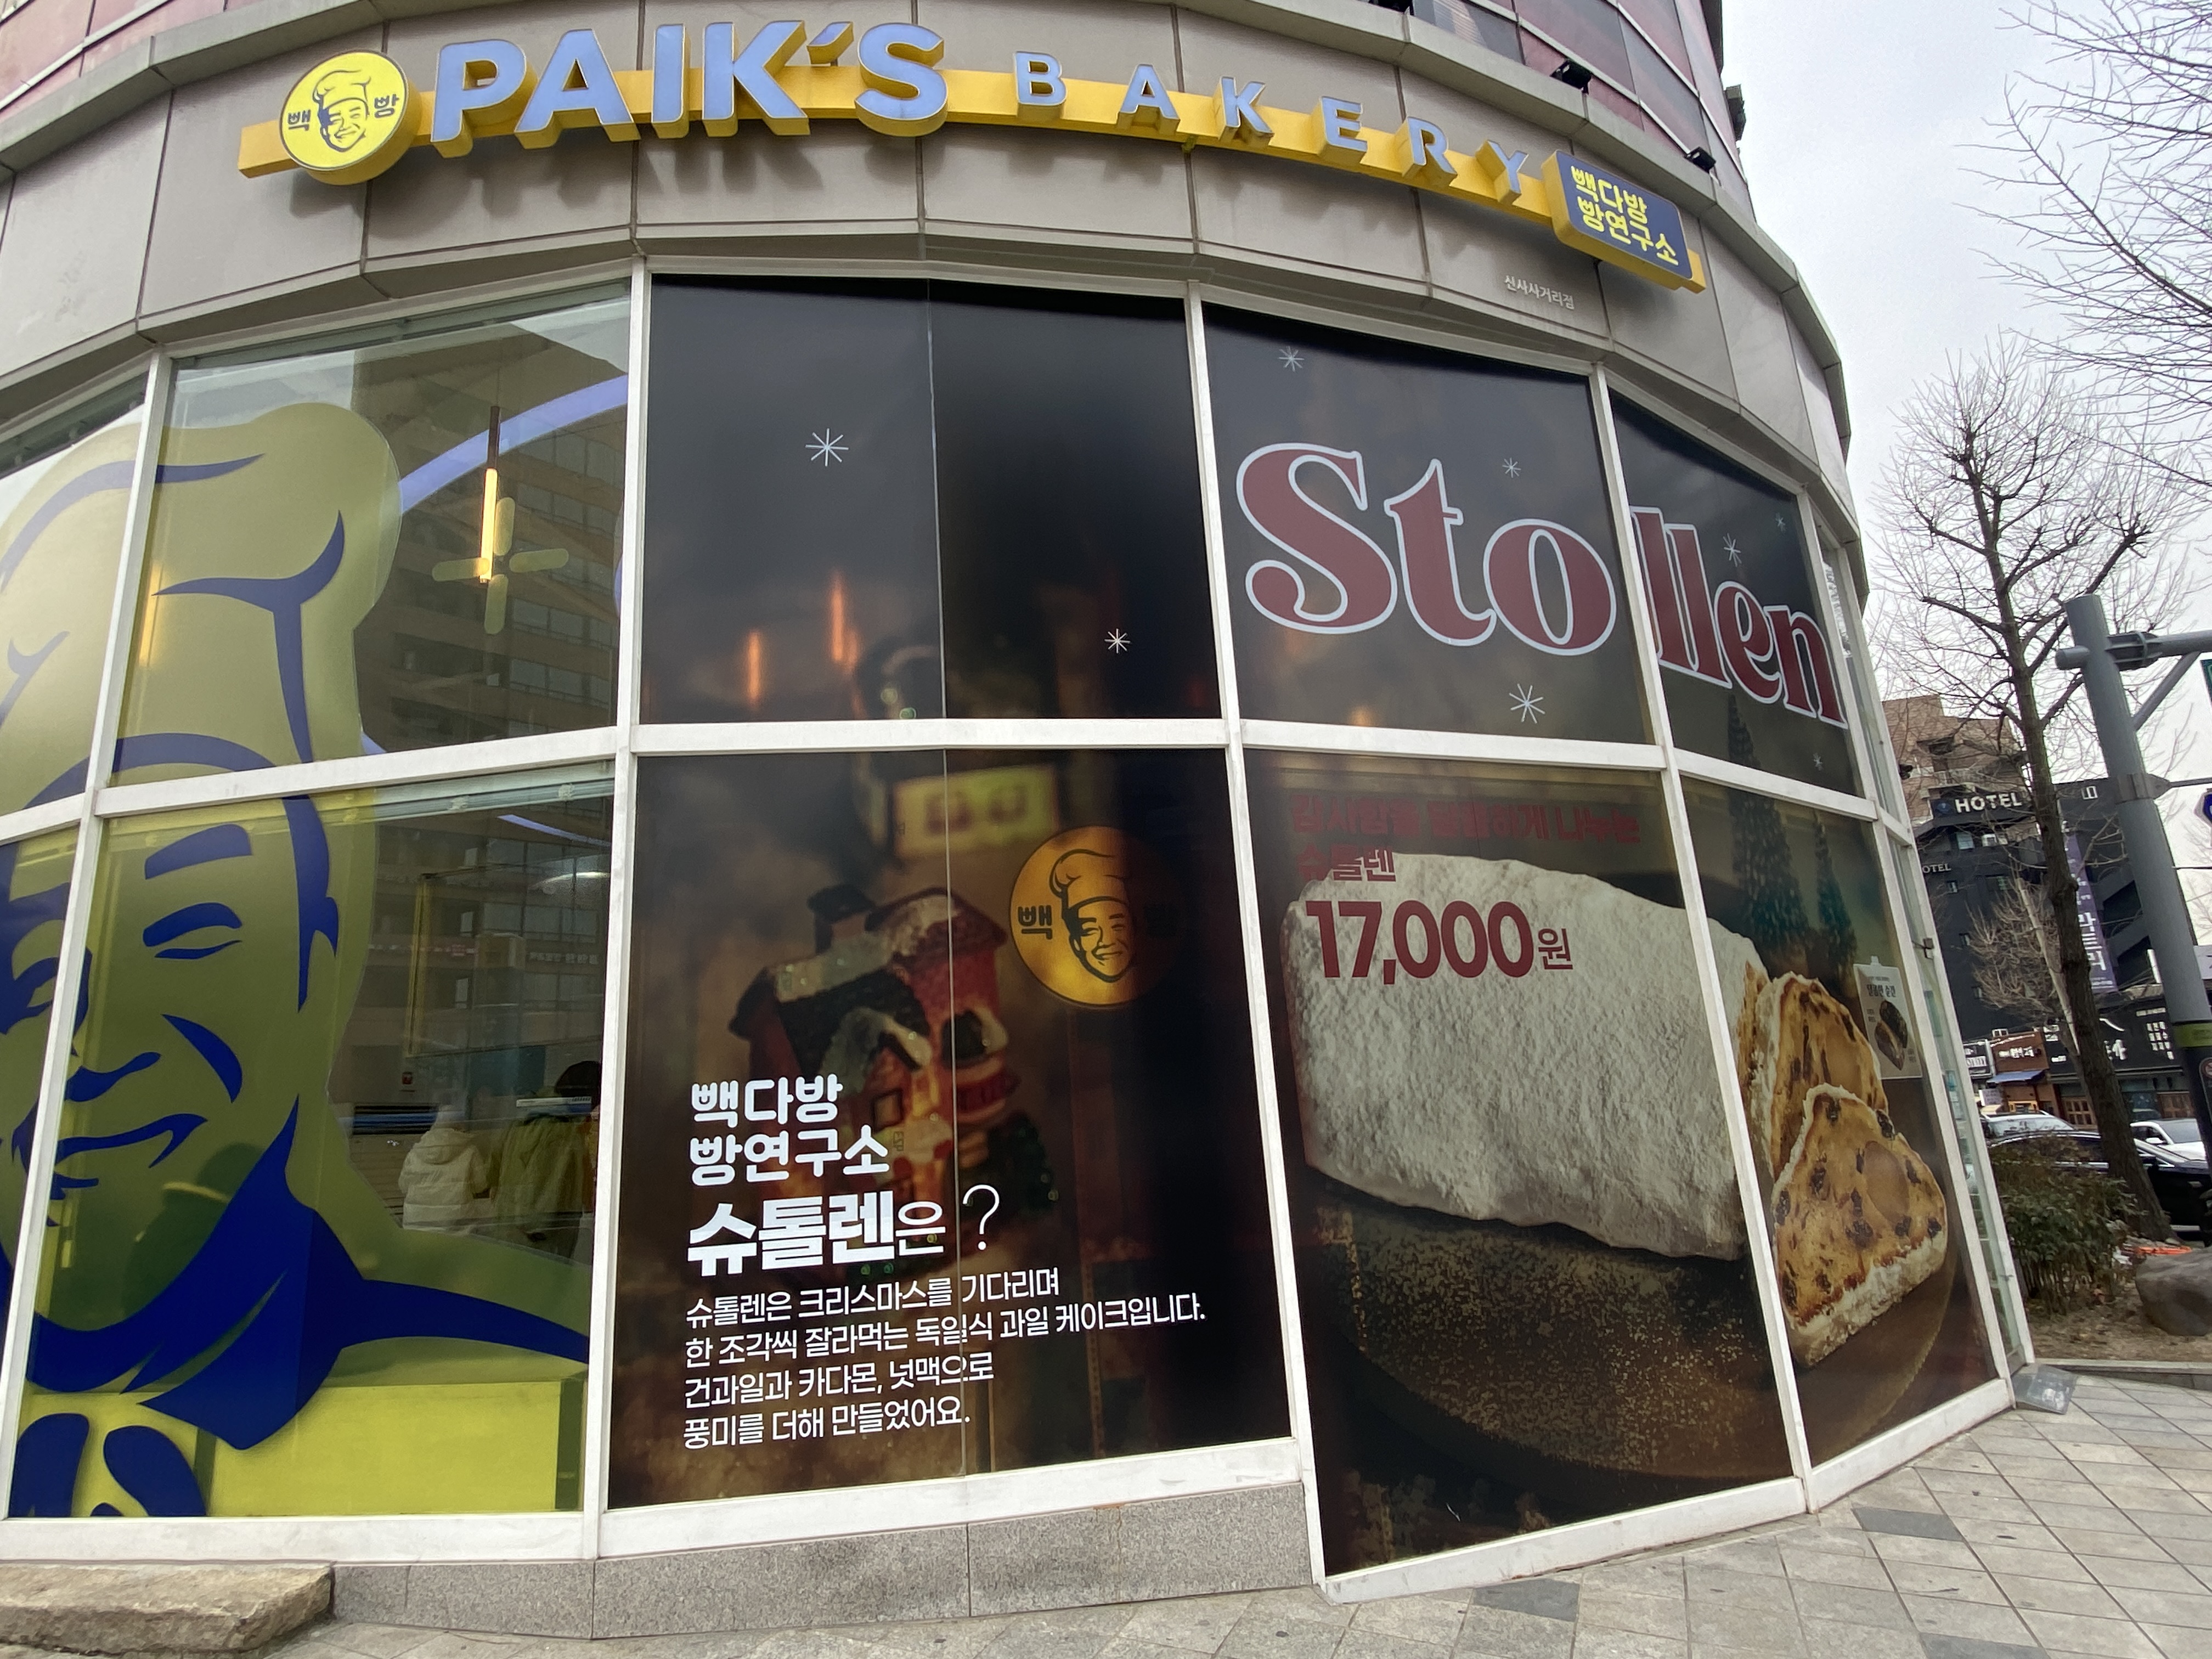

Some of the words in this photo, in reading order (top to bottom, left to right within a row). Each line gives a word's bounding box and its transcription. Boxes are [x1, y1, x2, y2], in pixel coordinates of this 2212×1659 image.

[374, 93, 399, 119] 빵
[431, 20, 947, 146] PAIK'S
[1015, 51, 1530, 200] BAKERY
[1571, 165, 1648, 224] 빽다방
[1576, 195, 1679, 266] 빵연구소
[1504, 275, 1575, 310] 신사사거리점
[1237, 442, 1849, 729] Stollen
[1955, 792, 2023, 814] HOTEL
[1922, 864, 1952, 873] OTEL
[1305, 900, 1573, 985] 17,000원
[692, 1074, 843, 1128] 빽다방
[690, 1125, 890, 1187] 빵연구소
[687, 1190, 946, 1277] 슈톨렌은
[686, 1291, 792, 1329] 슈톨렌은
[799, 1277, 953, 1318] 크리스마스를
[962, 1267, 1059, 1303] 기다리며
[686, 1337, 713, 1368] 한
[719, 1329, 798, 1364] 조각씩
[805, 1322, 909, 1358] 잘라먹는
[915, 1311, 993, 1346] 독일식
[1000, 1306, 1049, 1339] 과일
[1055, 1293, 1206, 1333] 케이크입니다.
[685, 1370, 793, 1408] 건과일과
[799, 1363, 882, 1397] 카다몬,
[890, 1352, 995, 1390] 넛맥으로
[684, 1413, 765, 1449] 풍미를
[772, 1407, 824, 1441] 더해
[832, 1396, 970, 1436] 만들었어요.
